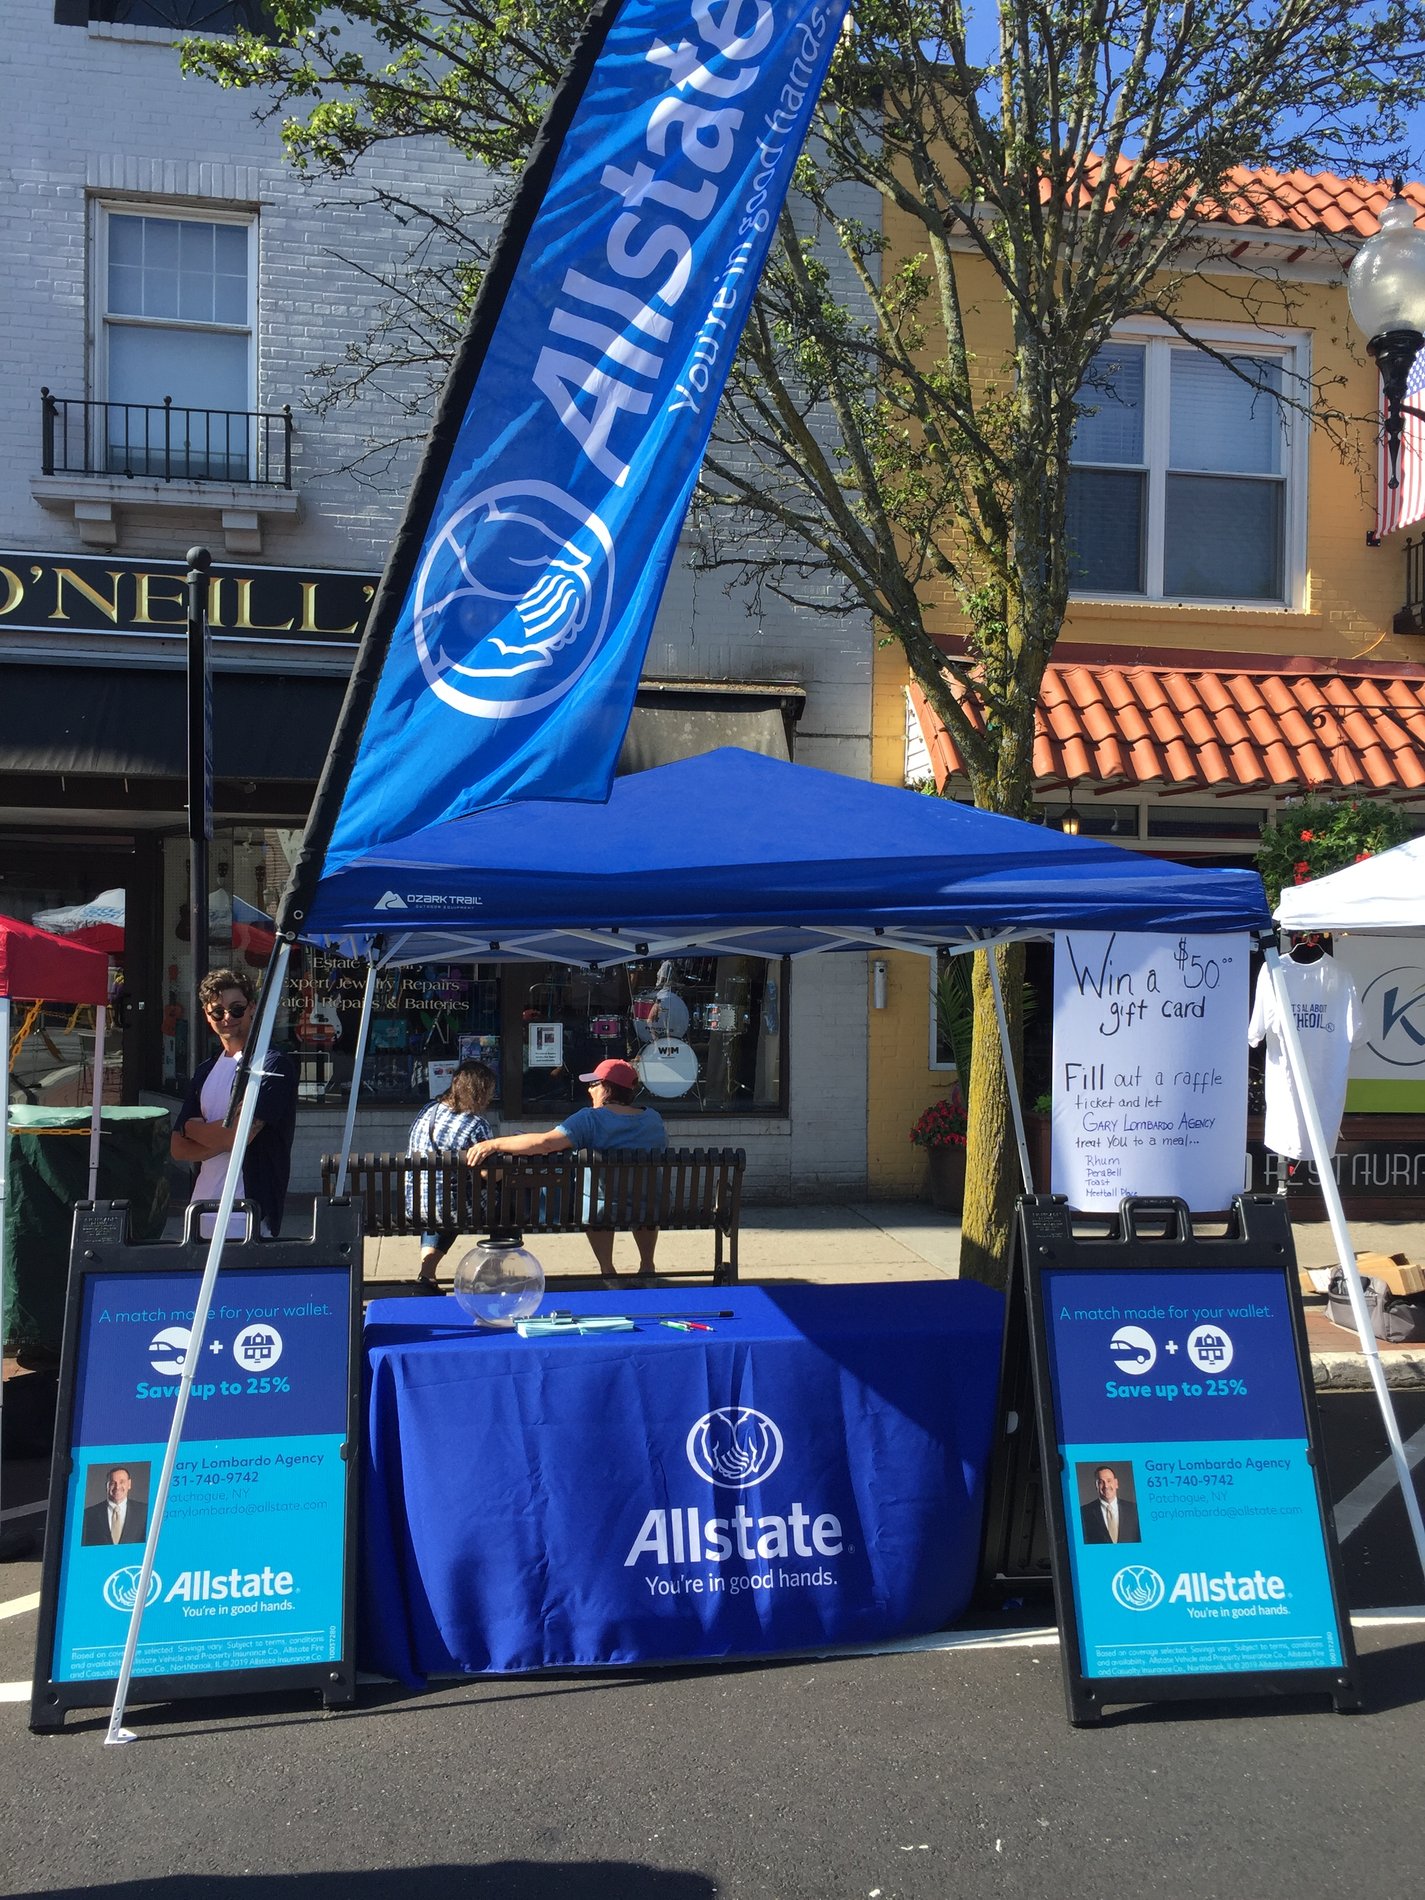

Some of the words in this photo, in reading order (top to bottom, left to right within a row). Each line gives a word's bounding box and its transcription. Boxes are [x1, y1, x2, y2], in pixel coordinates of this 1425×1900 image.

[668, 287, 737, 415] You're
[712, 242, 753, 282] in
[738, 135, 785, 236] good
[764, 7, 831, 134] hands.
[532, 0, 773, 488] Allstate
[407, 894, 448, 904] OZARK
[449, 895, 483, 905] TRAIL
[313, 957, 360, 969] Estate
[1066, 932, 1133, 999] Win
[1147, 969, 1160, 993] a
[336, 978, 393, 992] Jewlry
[403, 979, 460, 992] Repairs
[281, 996, 314, 1008] atch
[322, 997, 380, 1011] Repais
[386, 998, 397, 1008] &
[405, 998, 470, 1010] Batteries
[1100, 999, 1147, 1035] gift
[1162, 996, 1205, 1018] card
[1065, 1063, 1104, 1092] Fill
[1114, 1066, 1142, 1087] out
[1155, 1072, 1164, 1086] a
[1174, 1068, 1223, 1094] raffle
[1075, 1094, 1114, 1109] ticket
[1118, 1098, 1140, 1108] and
[1145, 1095, 1162, 1108] let
[1075, 1136, 1101, 1148] treat
[1133, 1136, 1144, 1146] to
[1149, 1137, 1156, 1146] a
[1264, 1153, 1425, 1186] RSTAURA
[98, 1310, 111, 1323] A
[116, 1308, 166, 1322] match
[171, 1309, 215, 1321] mae
[220, 1305, 242, 1319] for
[246, 1308, 279, 1321] your
[283, 1303, 332, 1316] wallet.
[1059, 1307, 1071, 1320] A
[1074, 1306, 1120, 1320] match
[1124, 1305, 1165, 1319] made
[1169, 1305, 1189, 1319] for
[1193, 1307, 1224, 1321] your
[1227, 1304, 1274, 1318] wallet.
[191, 1384, 216, 1401] up
[220, 1381, 242, 1395] to
[247, 1376, 290, 1394] 25%
[1105, 1381, 1152, 1398] Save
[1156, 1384, 1178, 1401] up
[1181, 1381, 1203, 1396] to
[1206, 1379, 1248, 1396] 25%
[175, 1460, 198, 1472] ary
[202, 1456, 271, 1469] Lombardo
[275, 1454, 325, 1467] Agency
[1145, 1459, 1175, 1473] Gary
[1179, 1458, 1242, 1471] Lombardo
[1246, 1457, 1291, 1471] Agency
[172, 1471, 259, 1487] 31-740-9742
[1147, 1474, 1234, 1488] 631-740-9742
[167, 1491, 228, 1504] atchogue,
[232, 1488, 251, 1499] NY
[1150, 1492, 1209, 1504] Patchogue,
[1211, 1490, 1228, 1500] NY
[623, 1502, 844, 1566] Allstate
[163, 1566, 294, 1603] Allstate
[645, 1575, 703, 1595] You're
[709, 1573, 725, 1592] in
[730, 1569, 774, 1594] good
[779, 1566, 838, 1588] hands.
[1168, 1570, 1286, 1603] Allstate
[182, 1604, 216, 1618] You're
[218, 1602, 229, 1615] in
[230, 1600, 258, 1616] good
[260, 1599, 296, 1613] hands.
[1187, 1607, 1219, 1619] You're
[1220, 1606, 1230, 1617] in
[1231, 1604, 1257, 1620] good
[1258, 1603, 1291, 1616] hands.
[86, 1659, 121, 1669] availabilit
